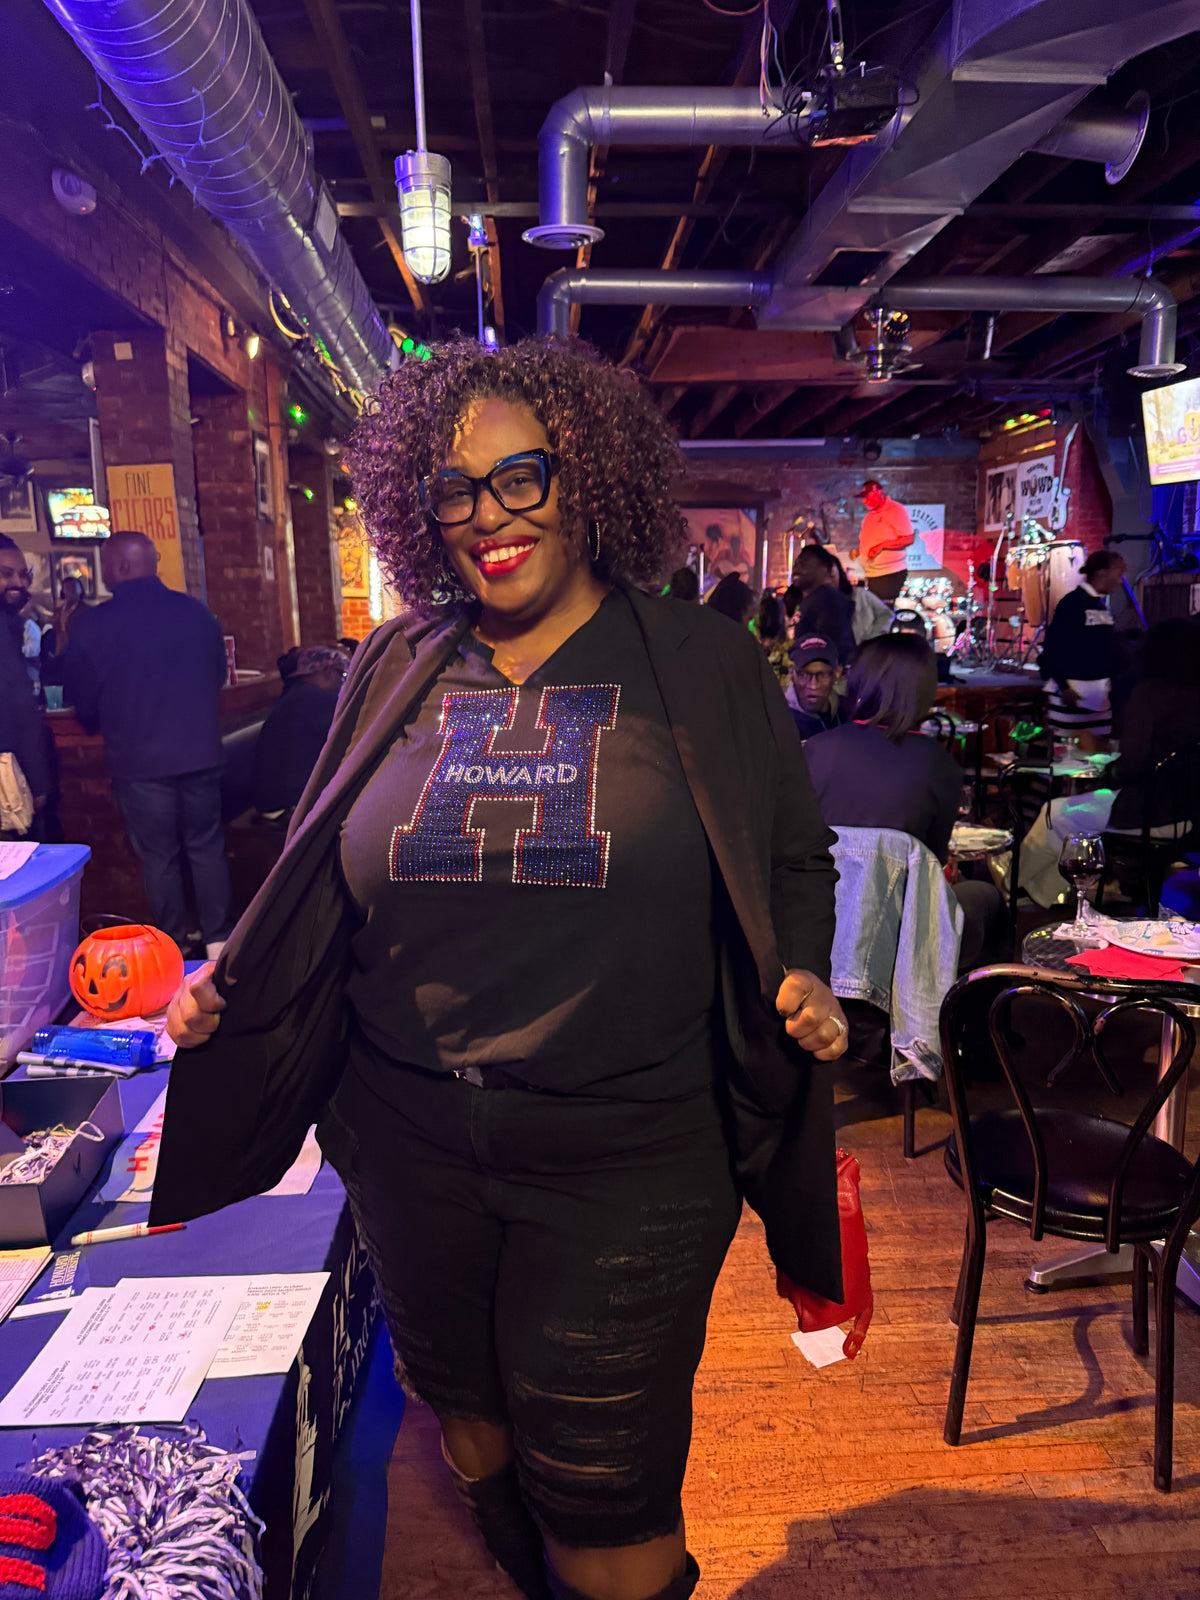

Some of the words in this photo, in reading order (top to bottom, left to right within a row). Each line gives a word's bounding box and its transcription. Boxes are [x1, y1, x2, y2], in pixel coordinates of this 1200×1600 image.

[124, 471, 155, 496] FINE
[112, 496, 176, 540] CIGARS
[389, 683, 621, 889] H
[445, 763, 578, 785] HOWARD
